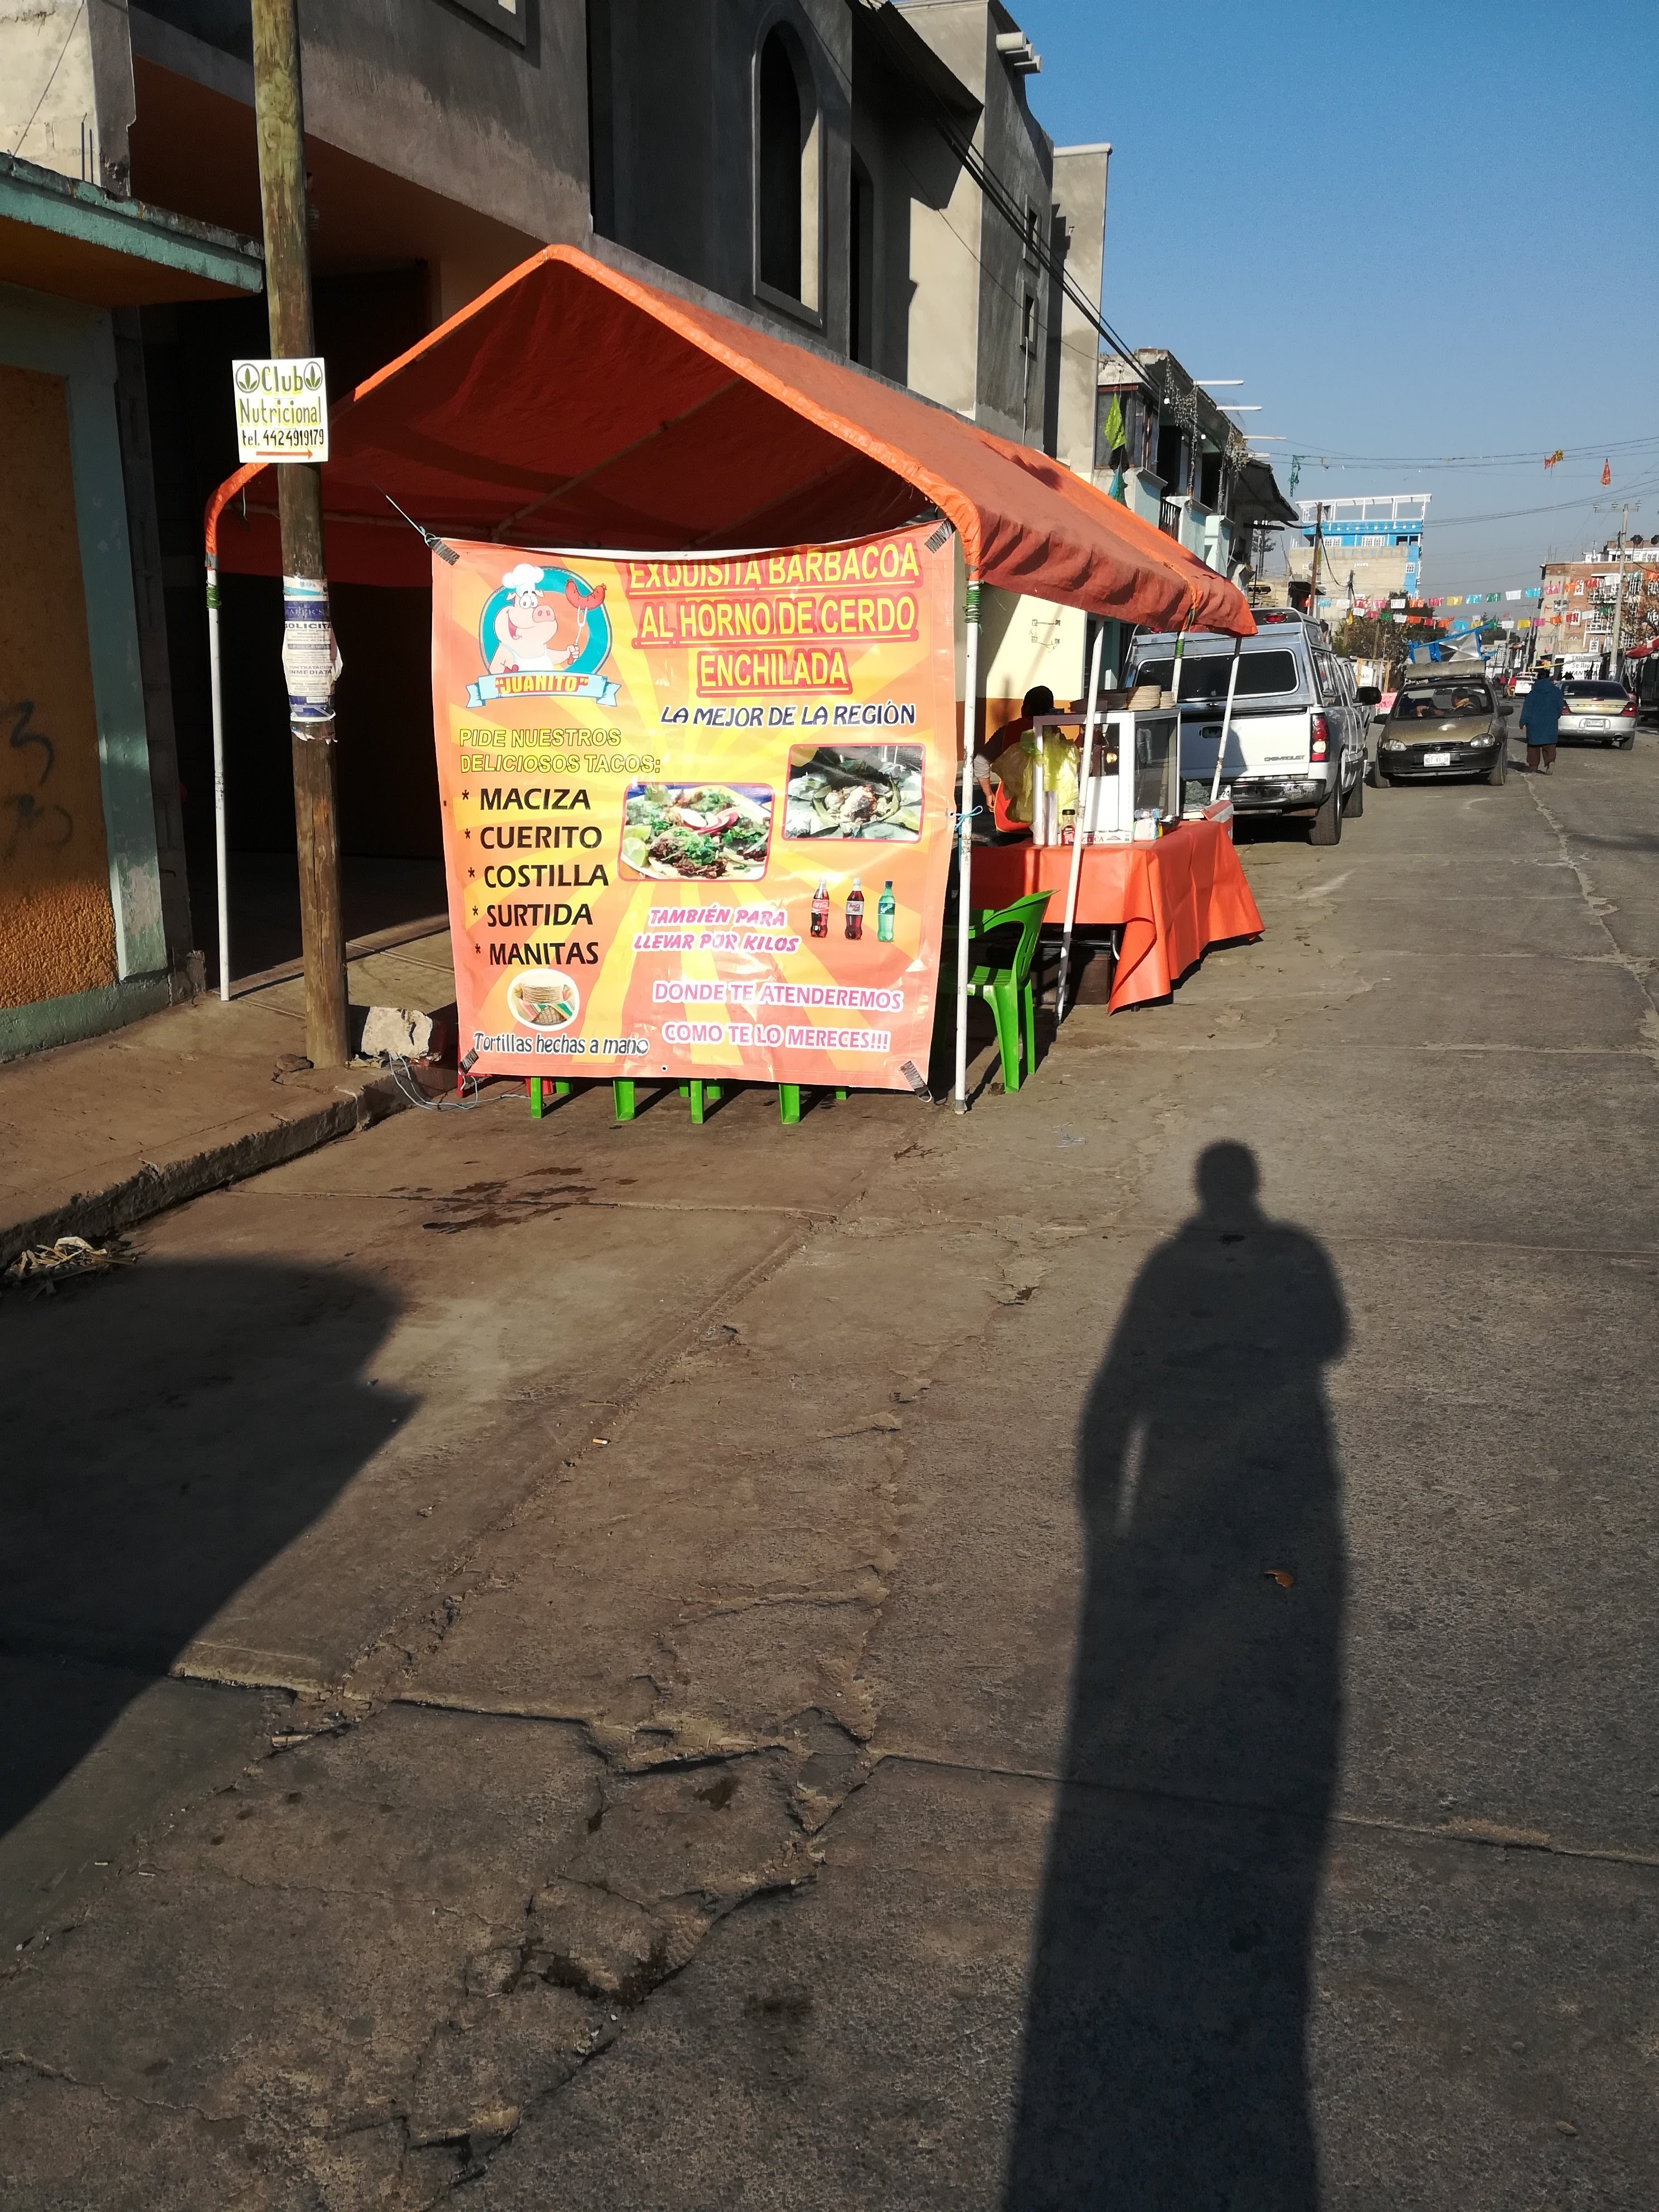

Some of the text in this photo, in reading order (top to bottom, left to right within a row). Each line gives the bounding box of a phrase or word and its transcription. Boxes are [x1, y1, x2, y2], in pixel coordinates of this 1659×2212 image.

[261, 365, 304, 392] Club
[239, 396, 322, 424] Nutricional
[242, 428, 324, 447] tel. 4424919179
[630, 542, 920, 589] EXQUISITA BARBACOA
[641, 595, 916, 638] AL HORNO DE CERDO
[700, 651, 847, 687] ENCHILADA
[661, 700, 915, 726] LA MEJOR DE LA REGIÓN
[459, 728, 622, 748] PIDE NUESTROS
[460, 754, 661, 774] DELICIOSOS TACOS:
[1263, 754, 1306, 763] CHEVROLET
[480, 788, 591, 811] MACIZA
[479, 825, 603, 850] CUERITO
[483, 864, 609, 889] COSTILLA
[487, 903, 594, 928] SURTIDA
[650, 905, 785, 926] TAMBIÉN PARA
[489, 942, 599, 966] MANITAS
[633, 934, 800, 952] LLEVAR POR KILOS
[654, 983, 902, 1010] DONDE TE ATENDEREMOS
[473, 1032, 649, 1055] Tortillas hechas a mano
[664, 1023, 889, 1051] COMO TE LO MERECES!!!
